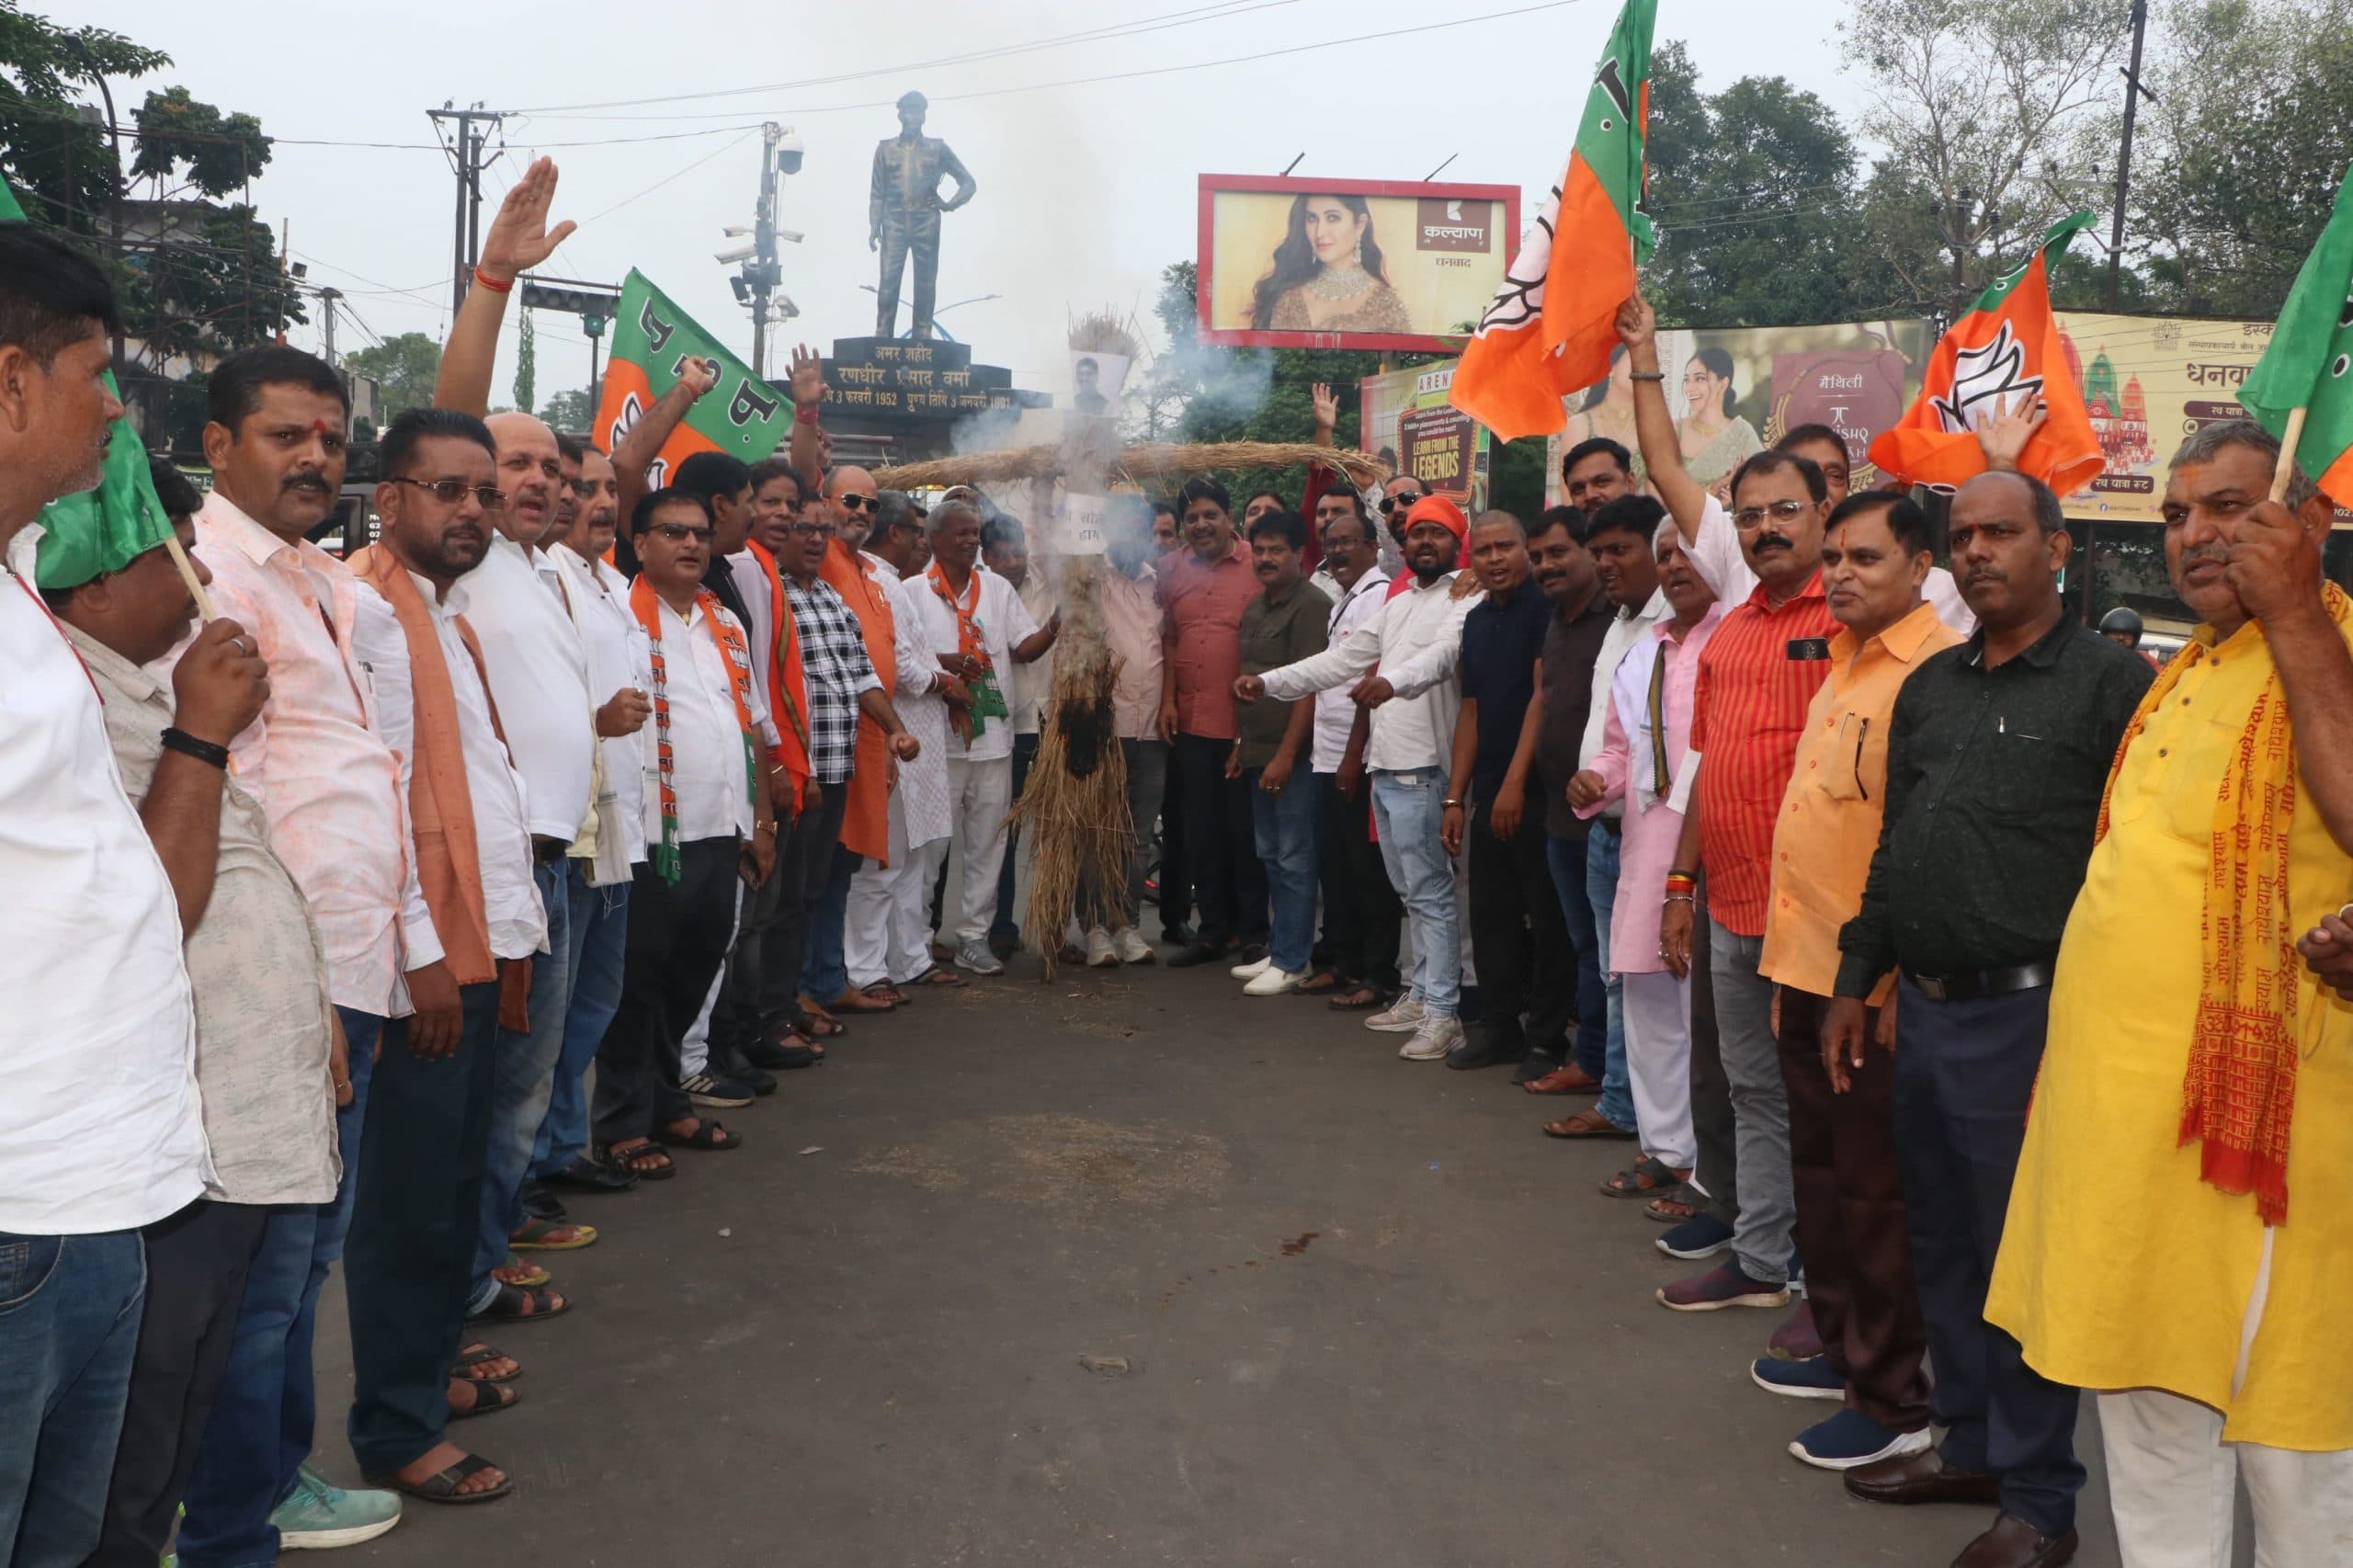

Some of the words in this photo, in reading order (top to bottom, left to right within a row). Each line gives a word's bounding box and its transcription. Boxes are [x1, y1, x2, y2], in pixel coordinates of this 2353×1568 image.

[1424, 225, 1484, 240] कल्याण
[875, 346, 902, 361] अमर
[905, 342, 933, 362] शहीद
[838, 362, 886, 384] रणधीर
[942, 365, 971, 387] वर्मा
[1819, 373, 1862, 389] मैथिली
[836, 390, 843, 404] 3
[846, 386, 871, 405] फरवरी
[875, 392, 897, 406] 1952
[928, 390, 948, 407] तिथि
[959, 391, 987, 408] जनवरी
[1413, 439, 1431, 456] LEARN
[1431, 437, 1448, 453] FROM
[1449, 435, 1460, 450] THE
[1413, 451, 1459, 481] LEGENDS
[2110, 479, 2131, 489] यात्रा
